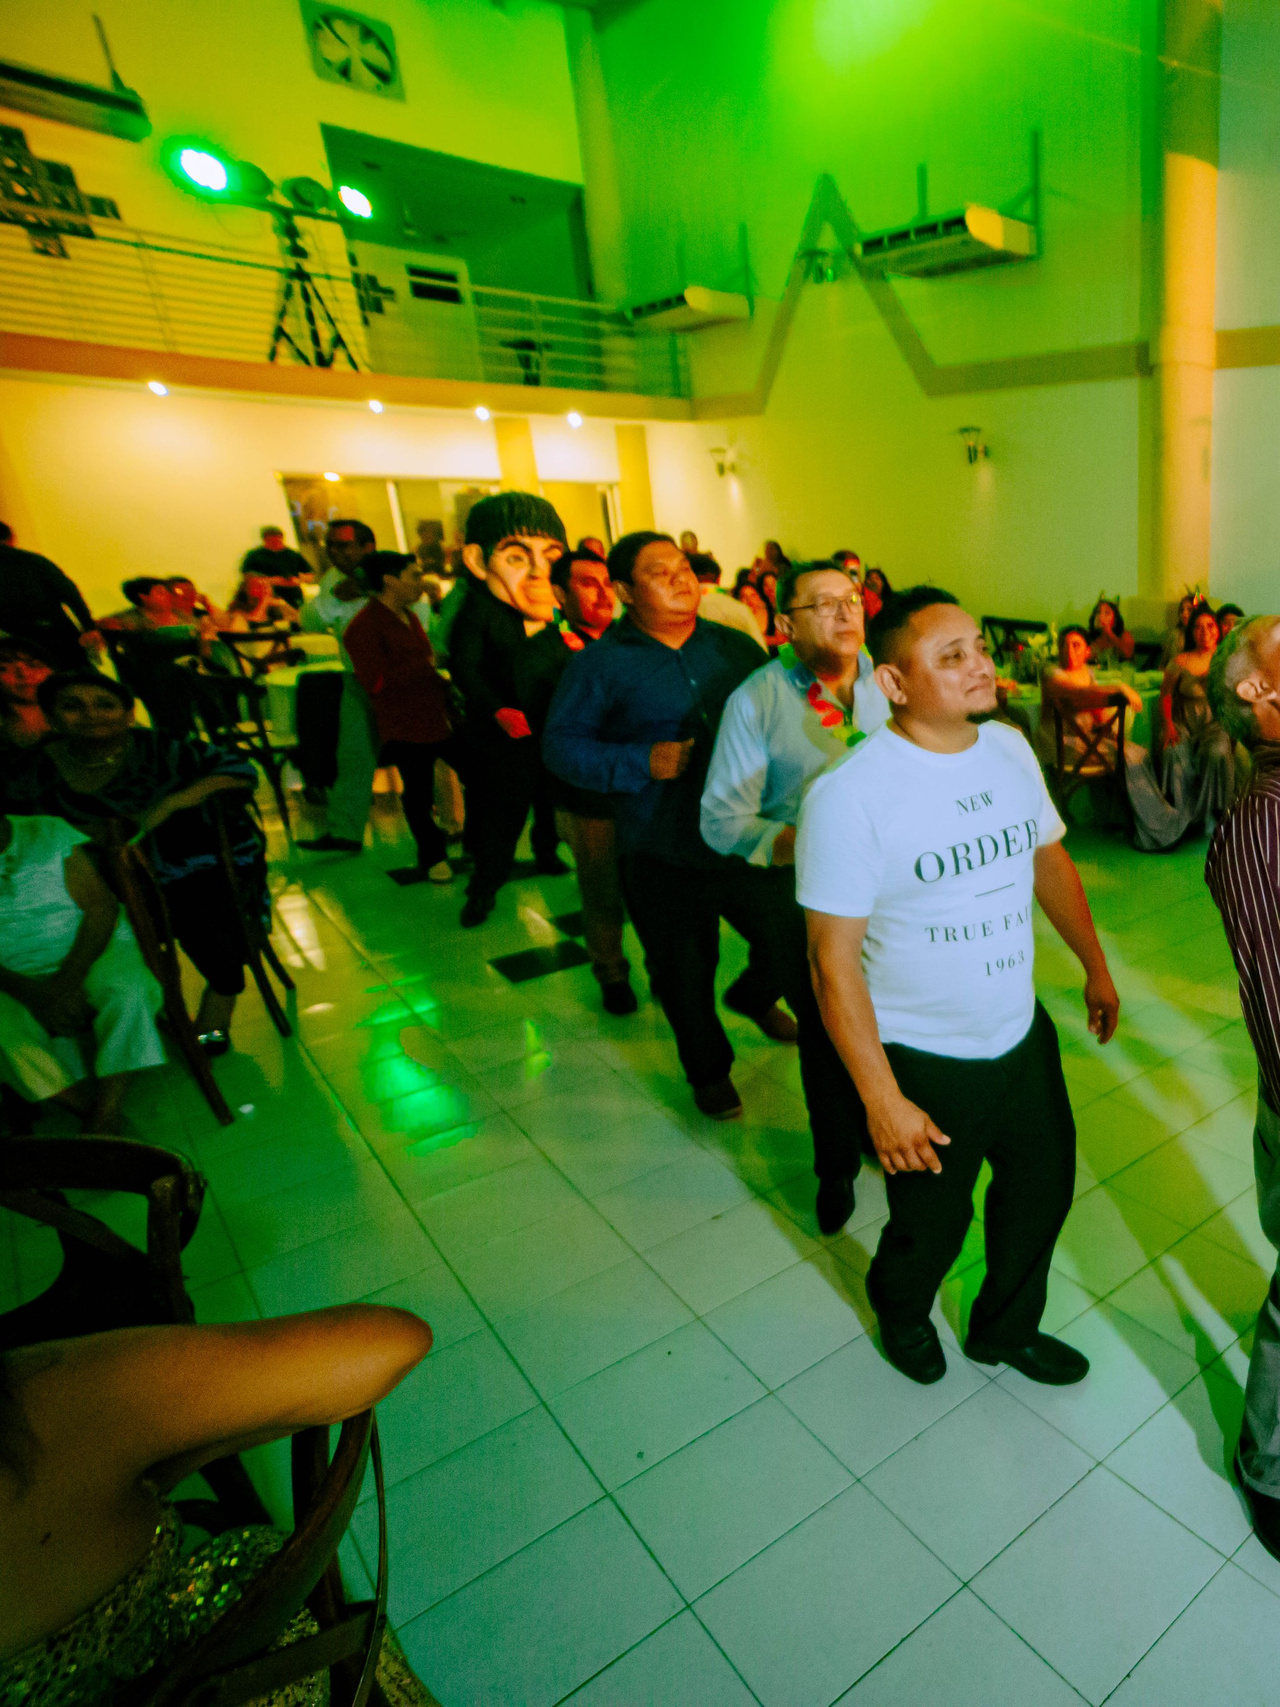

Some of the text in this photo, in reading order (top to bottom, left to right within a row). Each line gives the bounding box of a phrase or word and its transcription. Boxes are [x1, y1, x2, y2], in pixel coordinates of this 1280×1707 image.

[955, 790, 993, 816] NEW
[914, 818, 1039, 884] ORDER
[925, 919, 994, 943] TRUE
[985, 949, 1025, 977] 1963
